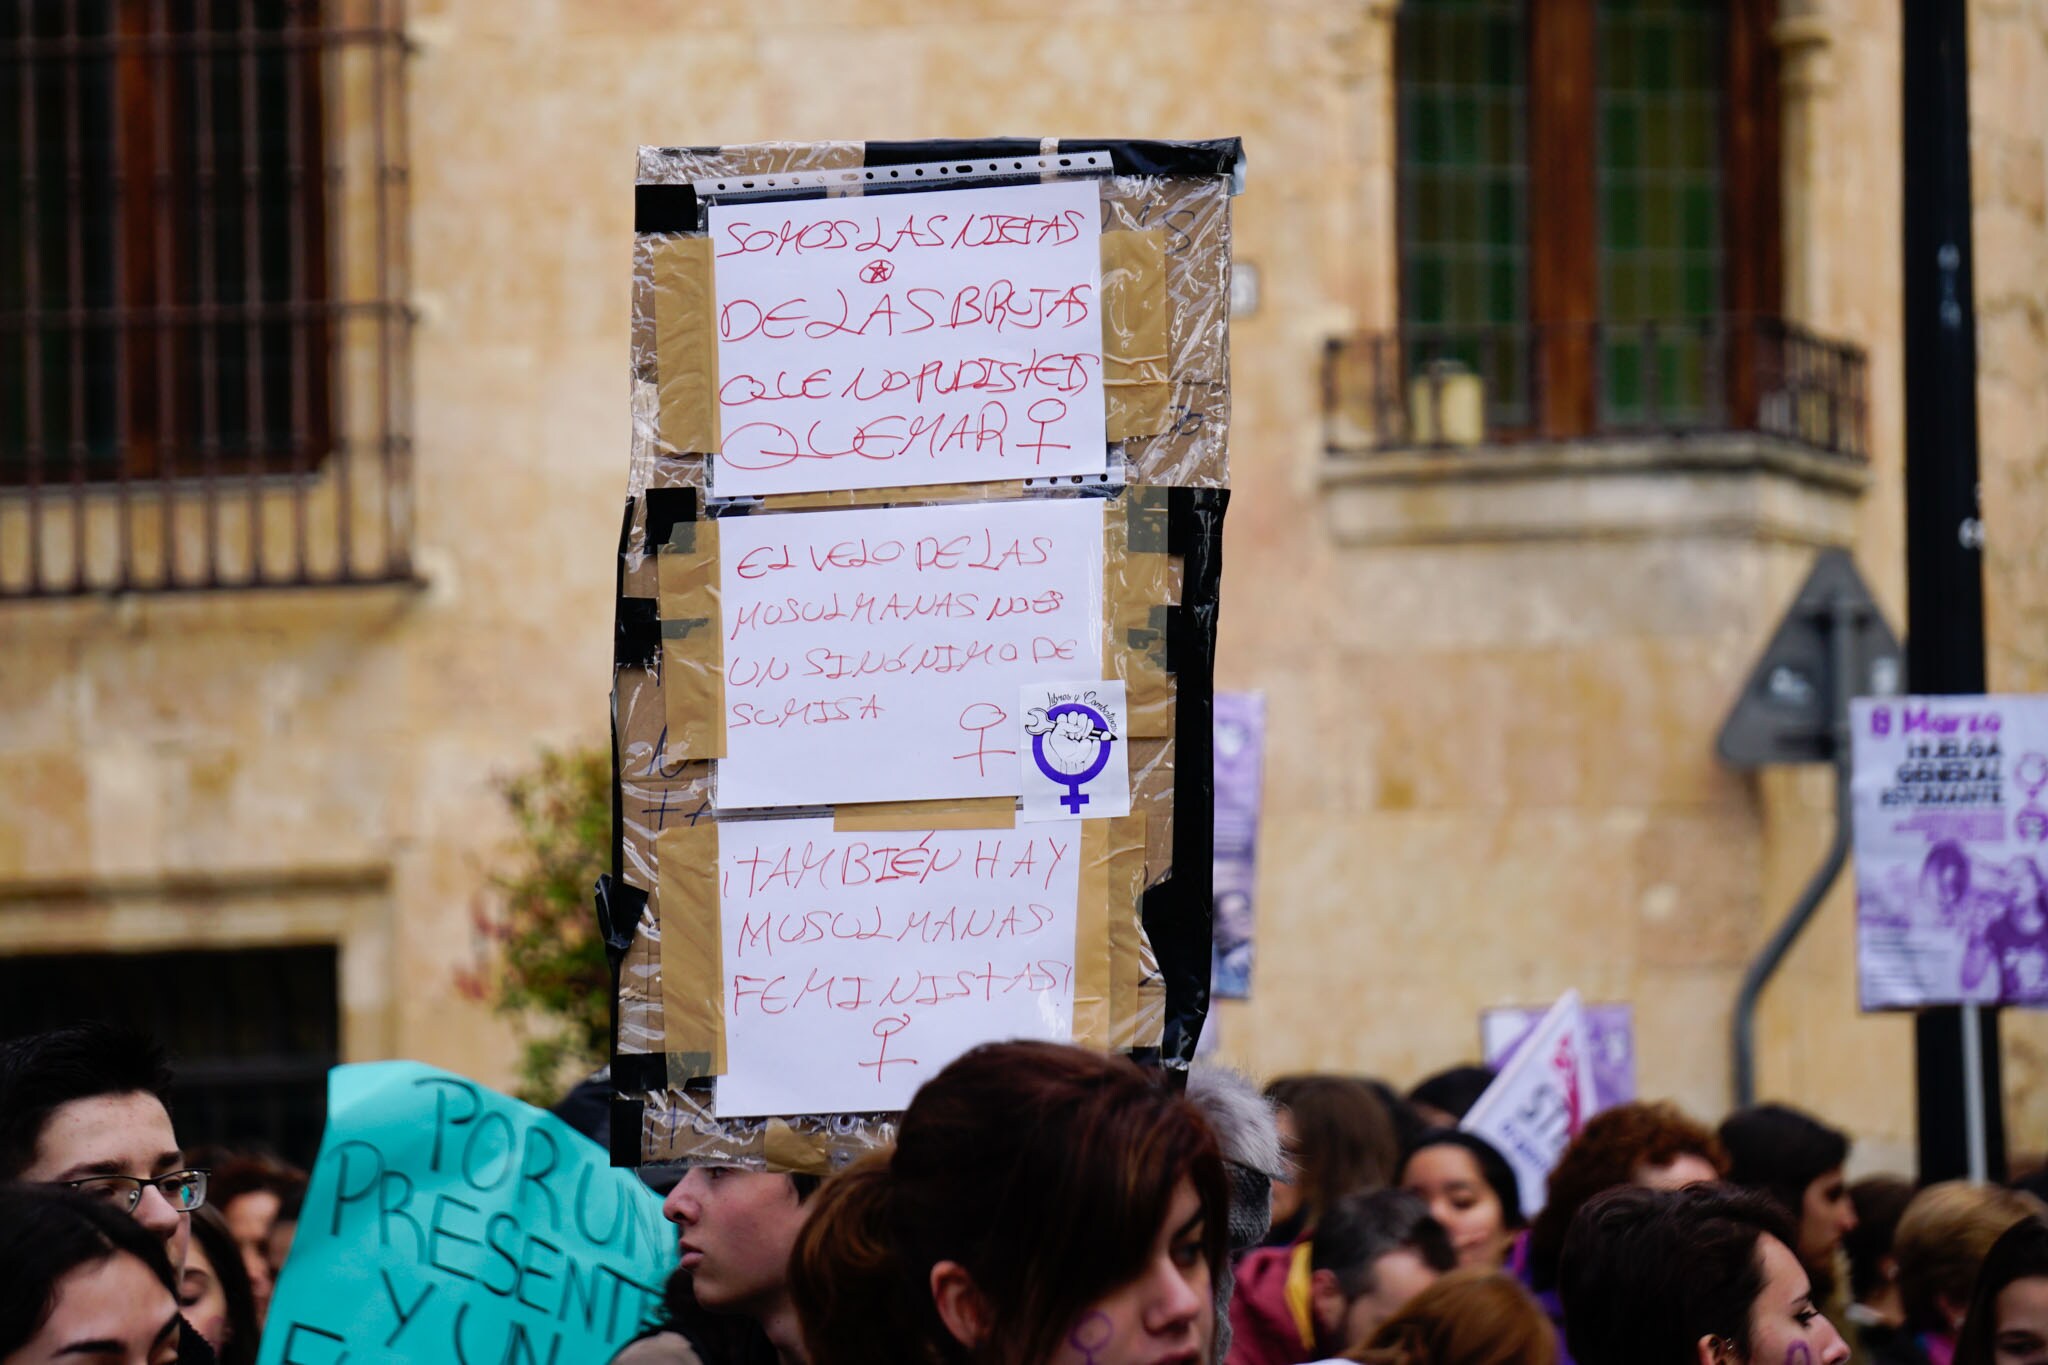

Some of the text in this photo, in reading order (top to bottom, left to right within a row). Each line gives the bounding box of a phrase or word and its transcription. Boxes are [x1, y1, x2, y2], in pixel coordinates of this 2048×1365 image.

[717, 220, 859, 257] SOMOS
[856, 214, 948, 252] LAS
[951, 210, 1085, 249] NIETAS
[720, 279, 1092, 342] DE LAS BRUJAS
[719, 369, 832, 405] QUE
[841, 367, 911, 401] NO
[720, 401, 1008, 470] QUEMAR
[736, 528, 1053, 579] EL VELO DE LAS
[729, 637, 1078, 688] UN SINÓNIMO DE
[729, 694, 885, 728] SUMISA
[976, 837, 1068, 890] HAY
[738, 905, 1054, 957] MUSULMANAS
[413, 1077, 560, 1232] POR
[574, 1162, 663, 1271] UN
[379, 1267, 436, 1347] Y
